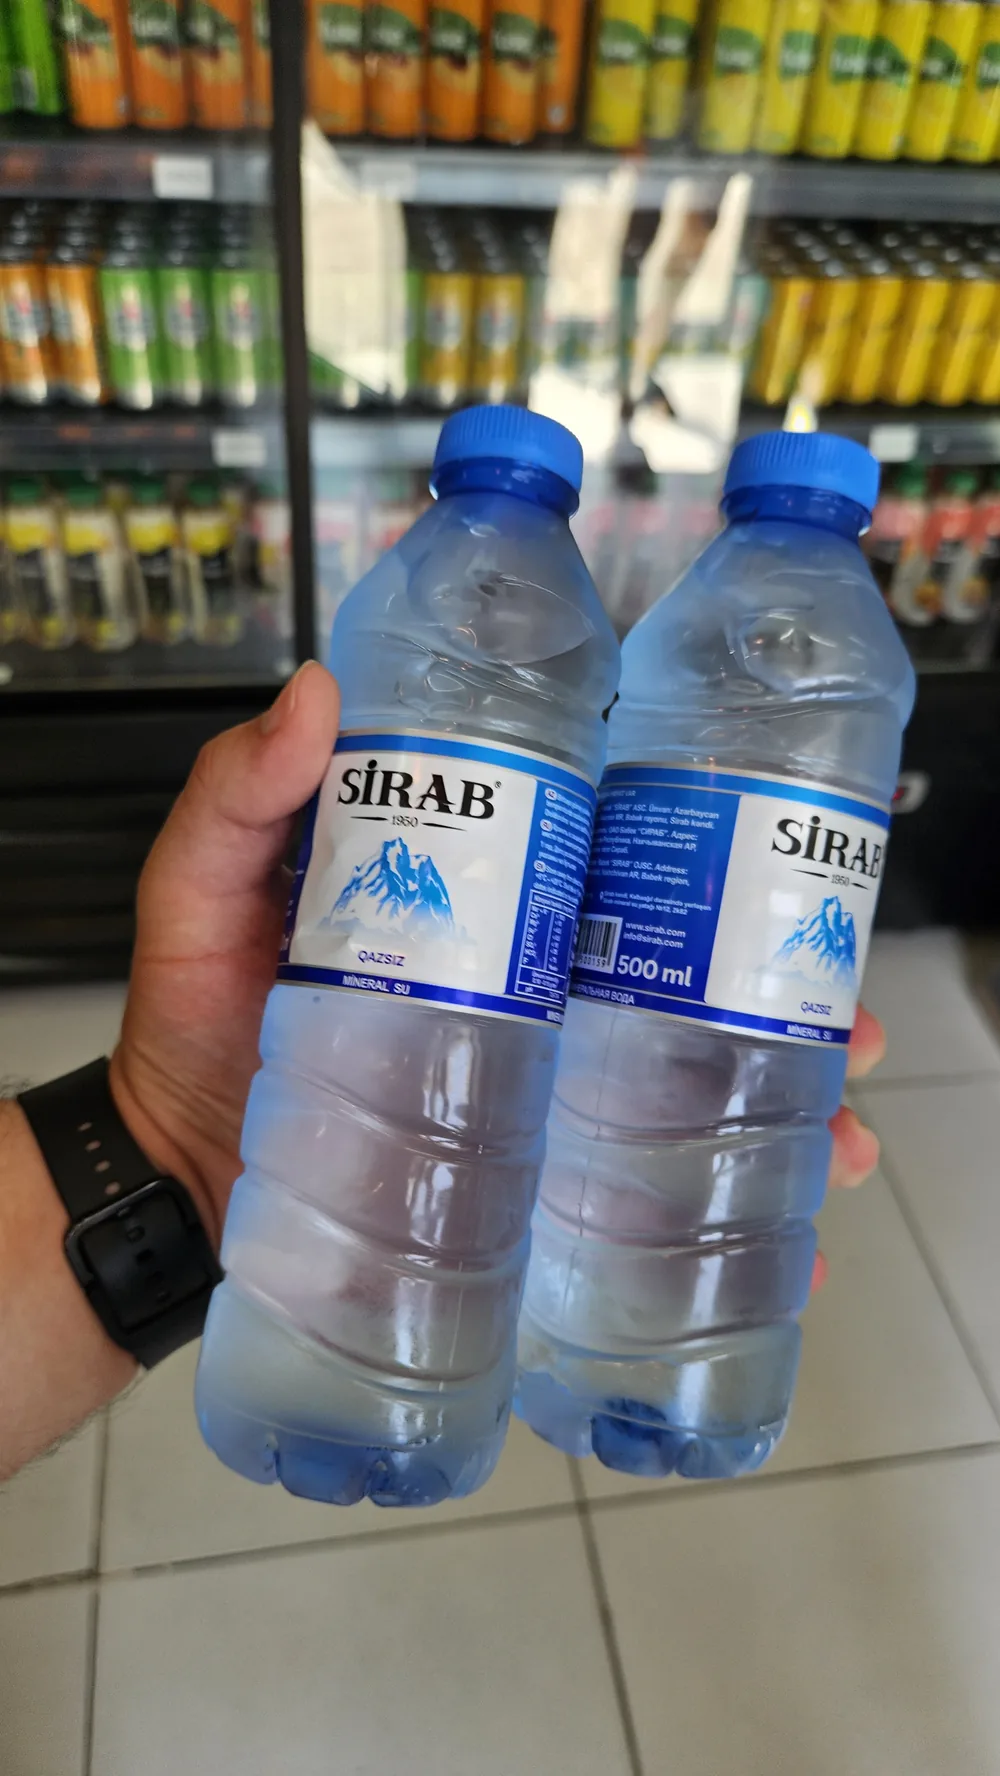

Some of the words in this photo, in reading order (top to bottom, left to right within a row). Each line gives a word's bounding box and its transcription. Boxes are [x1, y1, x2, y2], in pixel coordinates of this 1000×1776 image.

[336, 759, 495, 820] SİRAB
[391, 815, 419, 828] 1950
[654, 863, 688, 875] Address:
[830, 874, 850, 887] 1950
[625, 922, 686, 938] www.sirab.com
[623, 931, 684, 949] info@sirab.com
[617, 955, 659, 980] 500
[661, 966, 693, 988] ml
[393, 982, 411, 996] SU
